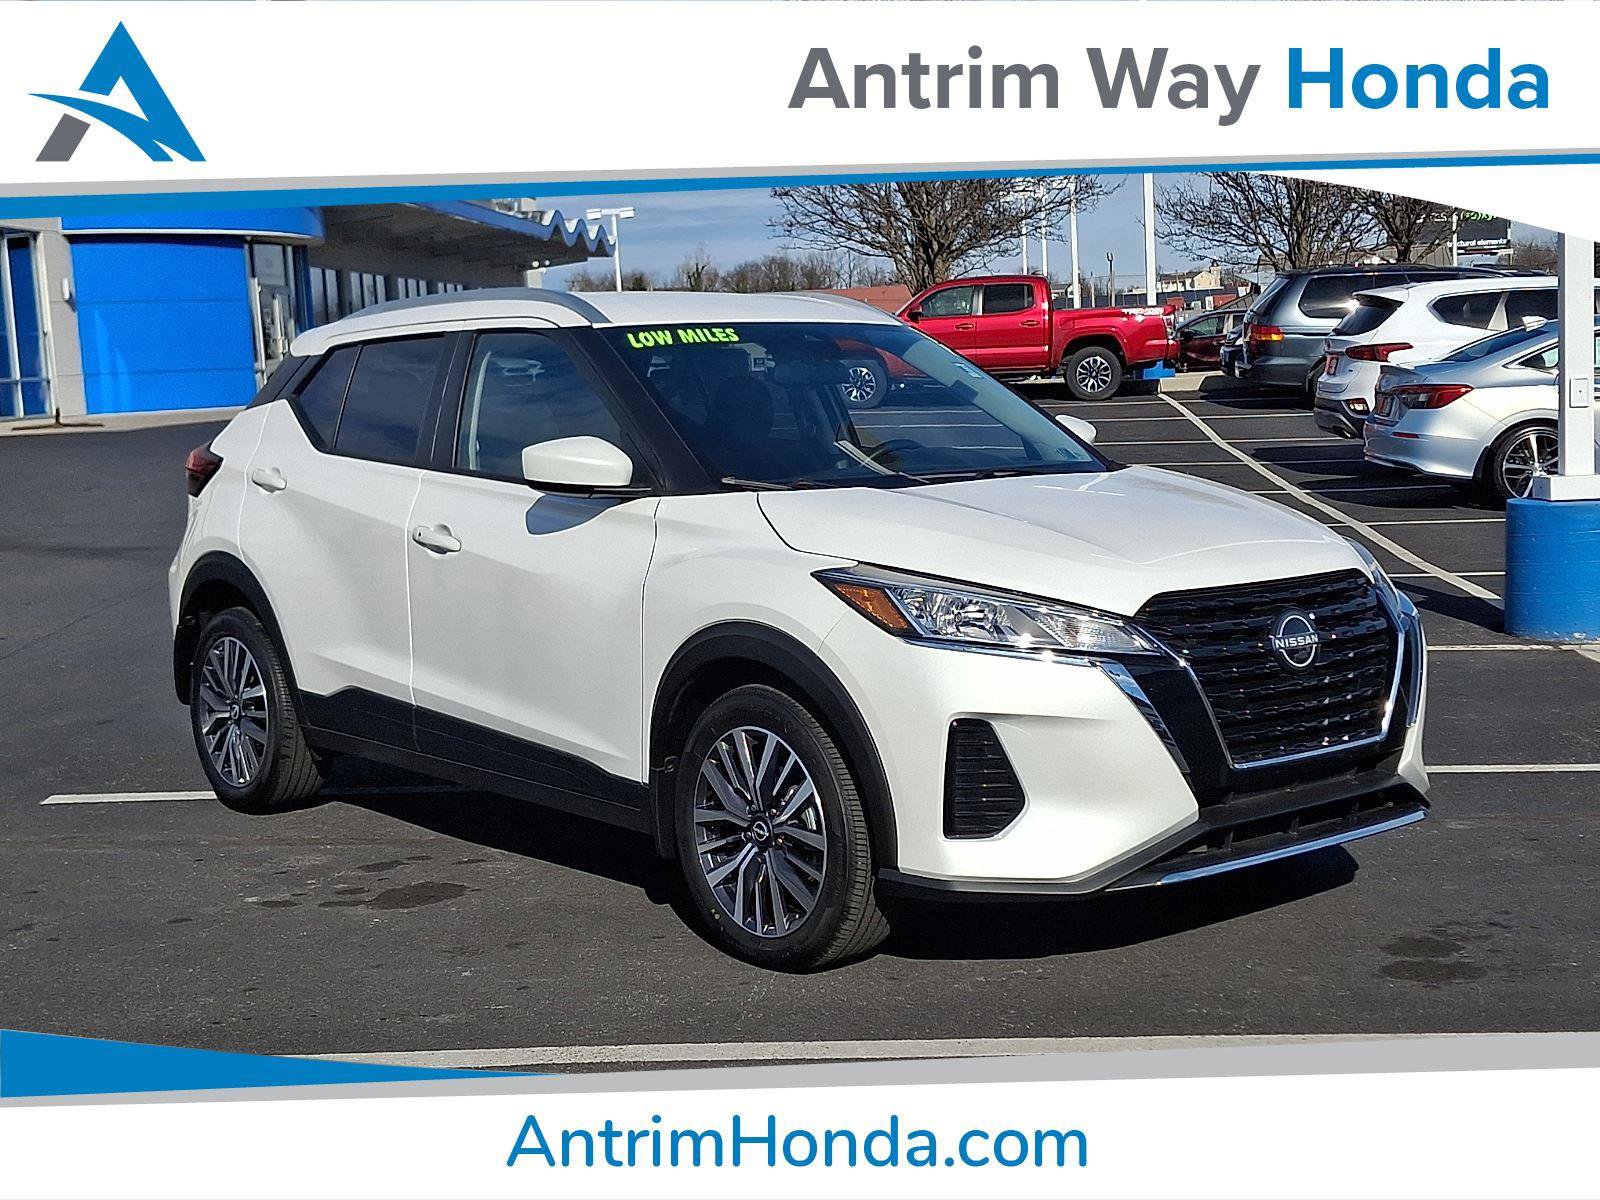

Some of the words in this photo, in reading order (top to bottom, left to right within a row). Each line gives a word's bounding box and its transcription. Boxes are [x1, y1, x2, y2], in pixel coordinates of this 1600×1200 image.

[627, 330, 673, 349] LOW
[677, 327, 740, 344] MILES
[1274, 633, 1319, 649] NISSAN
